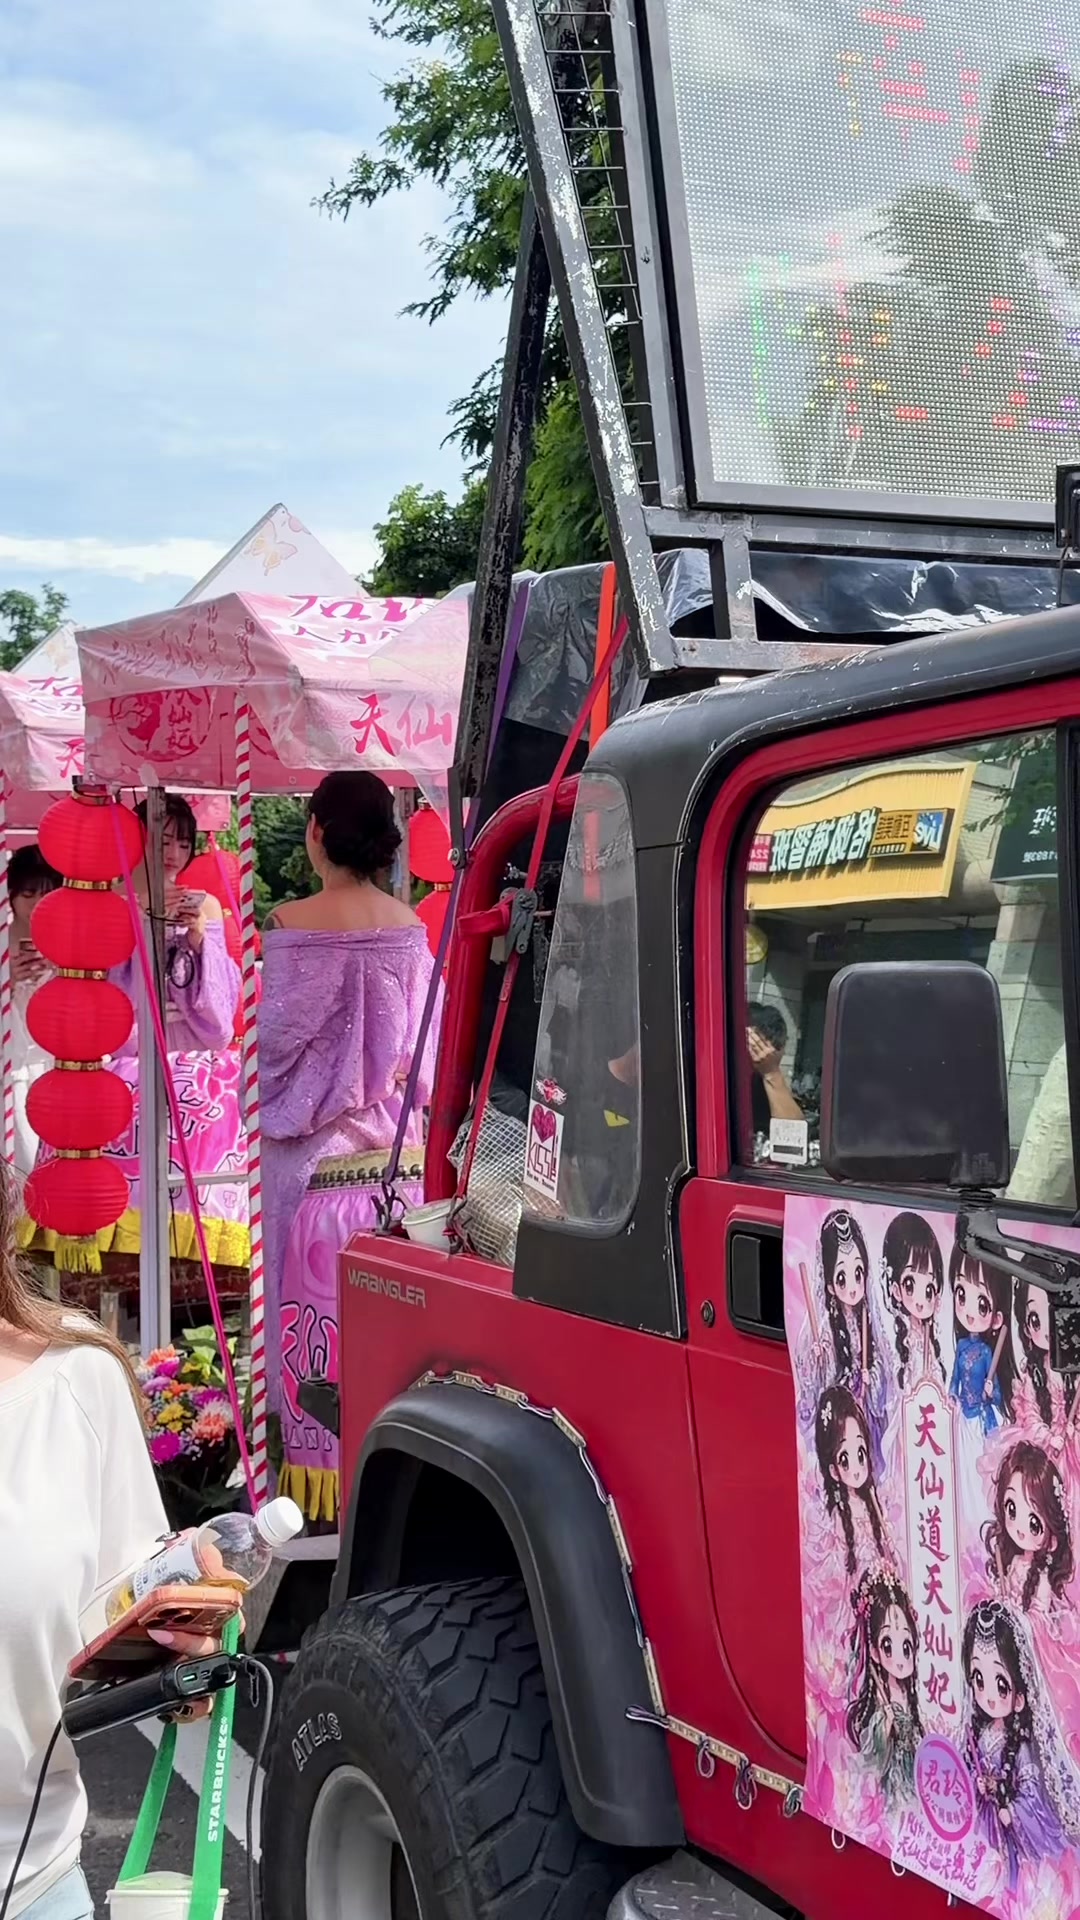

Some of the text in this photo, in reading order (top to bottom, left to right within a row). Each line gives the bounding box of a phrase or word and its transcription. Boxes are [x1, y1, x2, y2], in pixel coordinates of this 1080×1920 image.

[350, 693, 453, 757] 天仙
[347, 1265, 426, 1309] WRANGLER
[291, 1712, 342, 1772] ATLAS
[923, 1758, 968, 1806] 君玲
